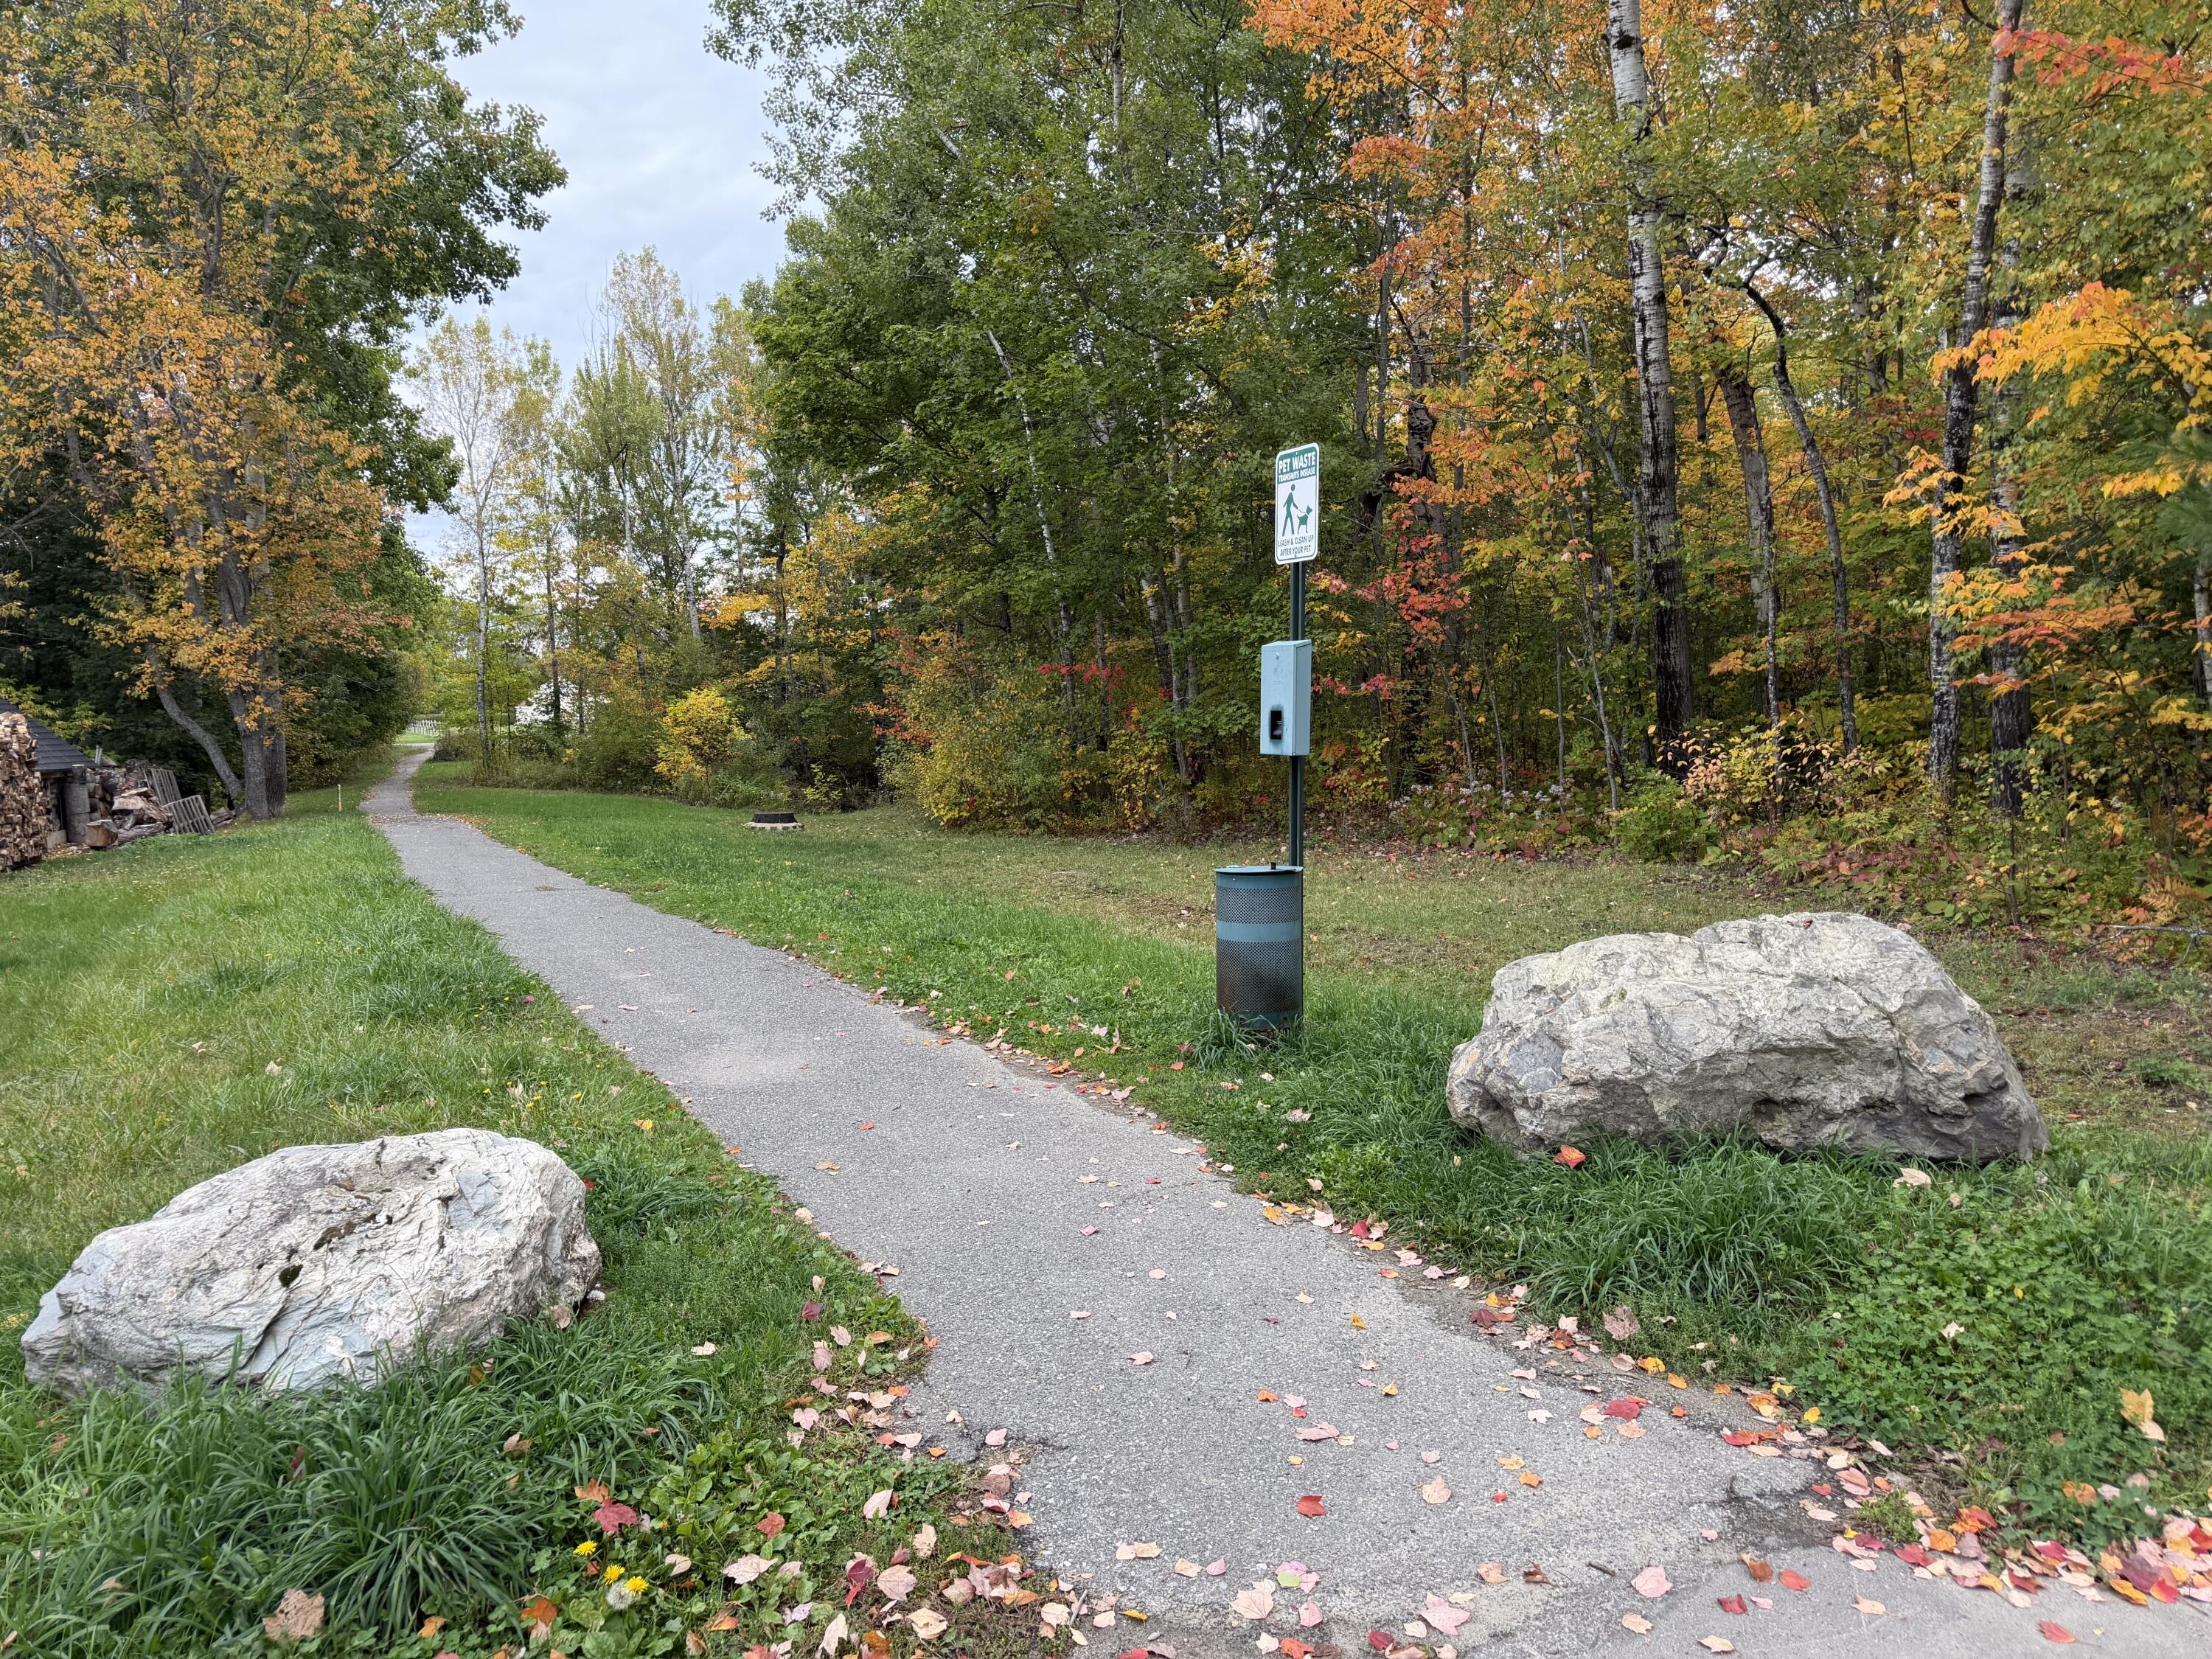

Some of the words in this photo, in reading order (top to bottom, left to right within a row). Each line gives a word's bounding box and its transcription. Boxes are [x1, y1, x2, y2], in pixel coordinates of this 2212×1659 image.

[1279, 458, 1290, 473] PET
[1292, 452, 1315, 470] WASTE
[1300, 467, 1315, 477] DISEASE
[1278, 538, 1290, 547] LEASH
[1295, 536, 1307, 544] CLEAN
[1280, 548, 1292, 556] AFTER
[1293, 546, 1303, 554] YOUR
